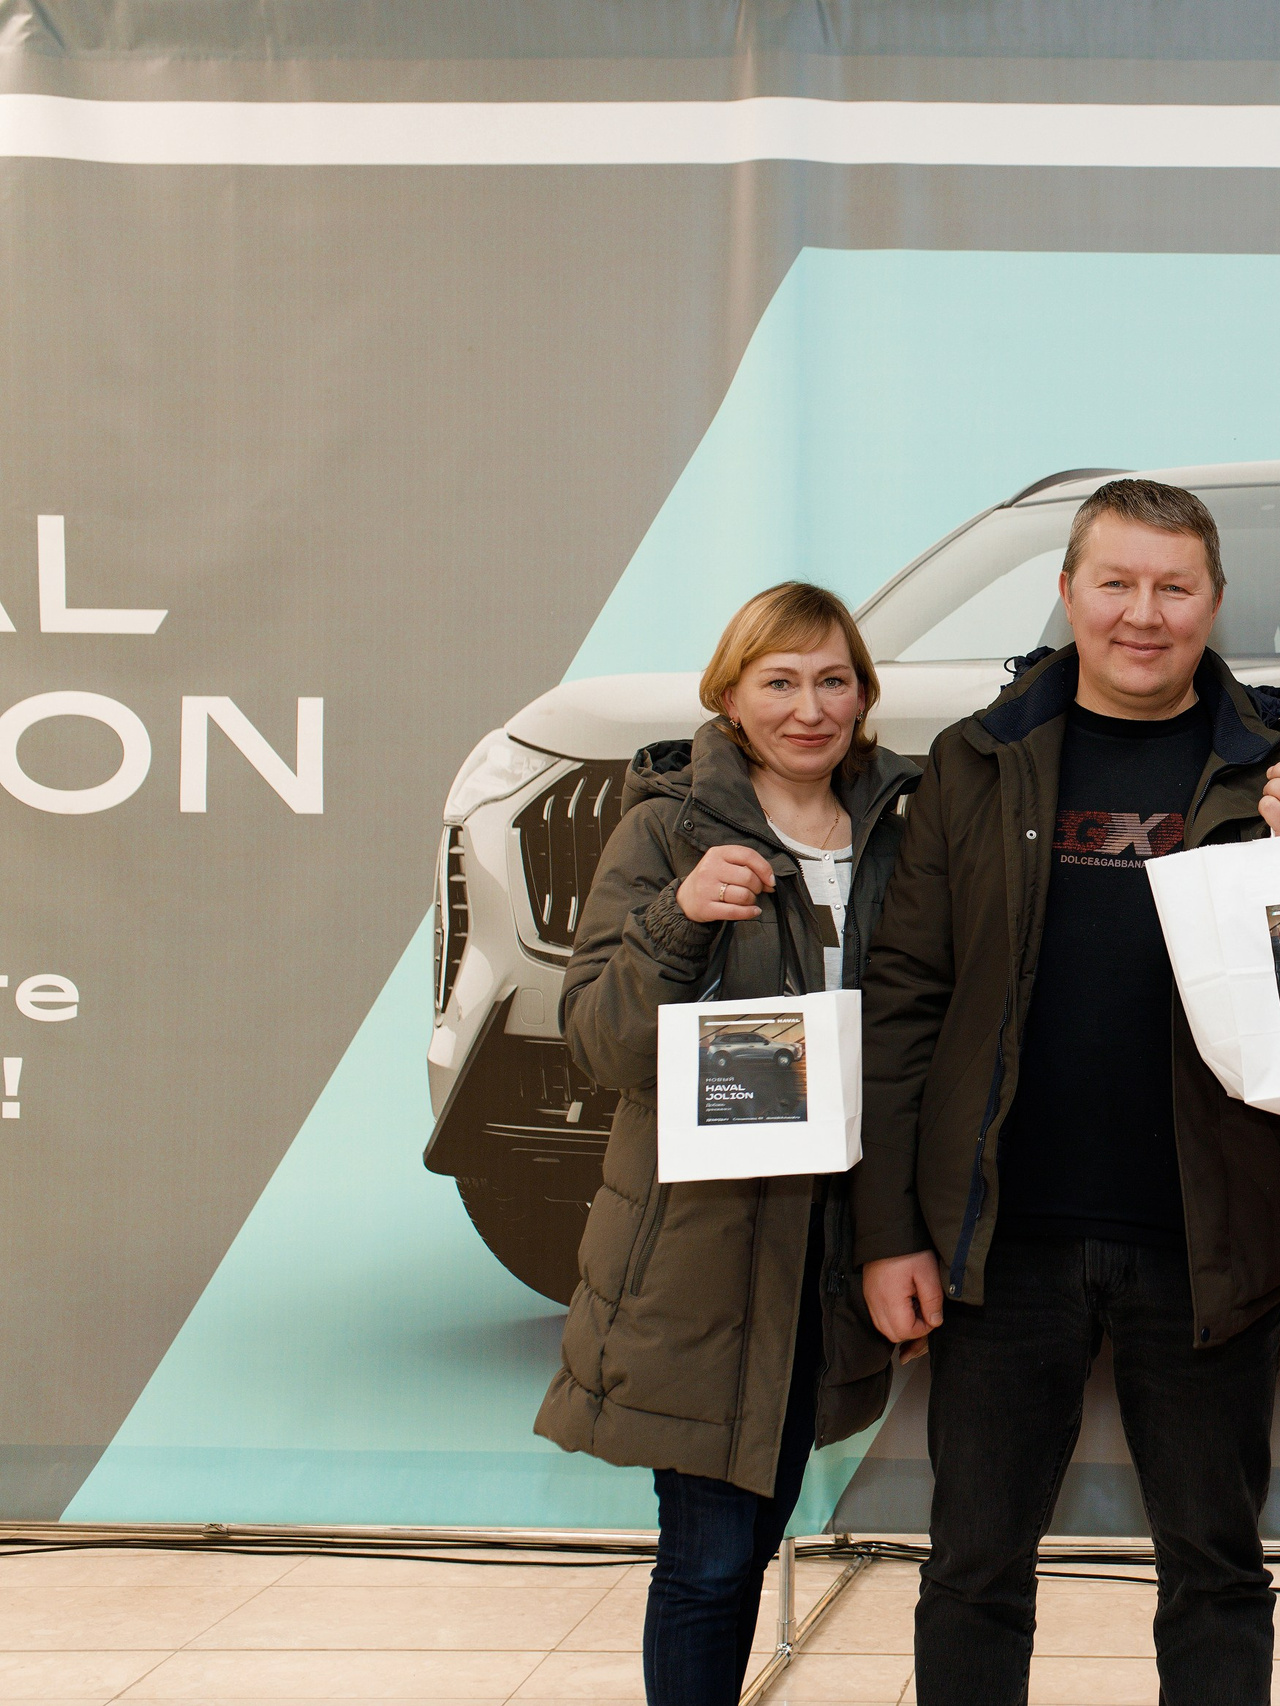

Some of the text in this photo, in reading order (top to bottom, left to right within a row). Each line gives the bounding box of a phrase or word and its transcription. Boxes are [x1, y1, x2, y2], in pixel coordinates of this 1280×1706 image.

[0, 515, 168, 634] L
[0, 691, 324, 815] ON
[1060, 854, 1147, 869] DOLCE&GABBANA
[705, 1084, 746, 1092] HAVAL
[705, 1092, 754, 1101] JOLION
